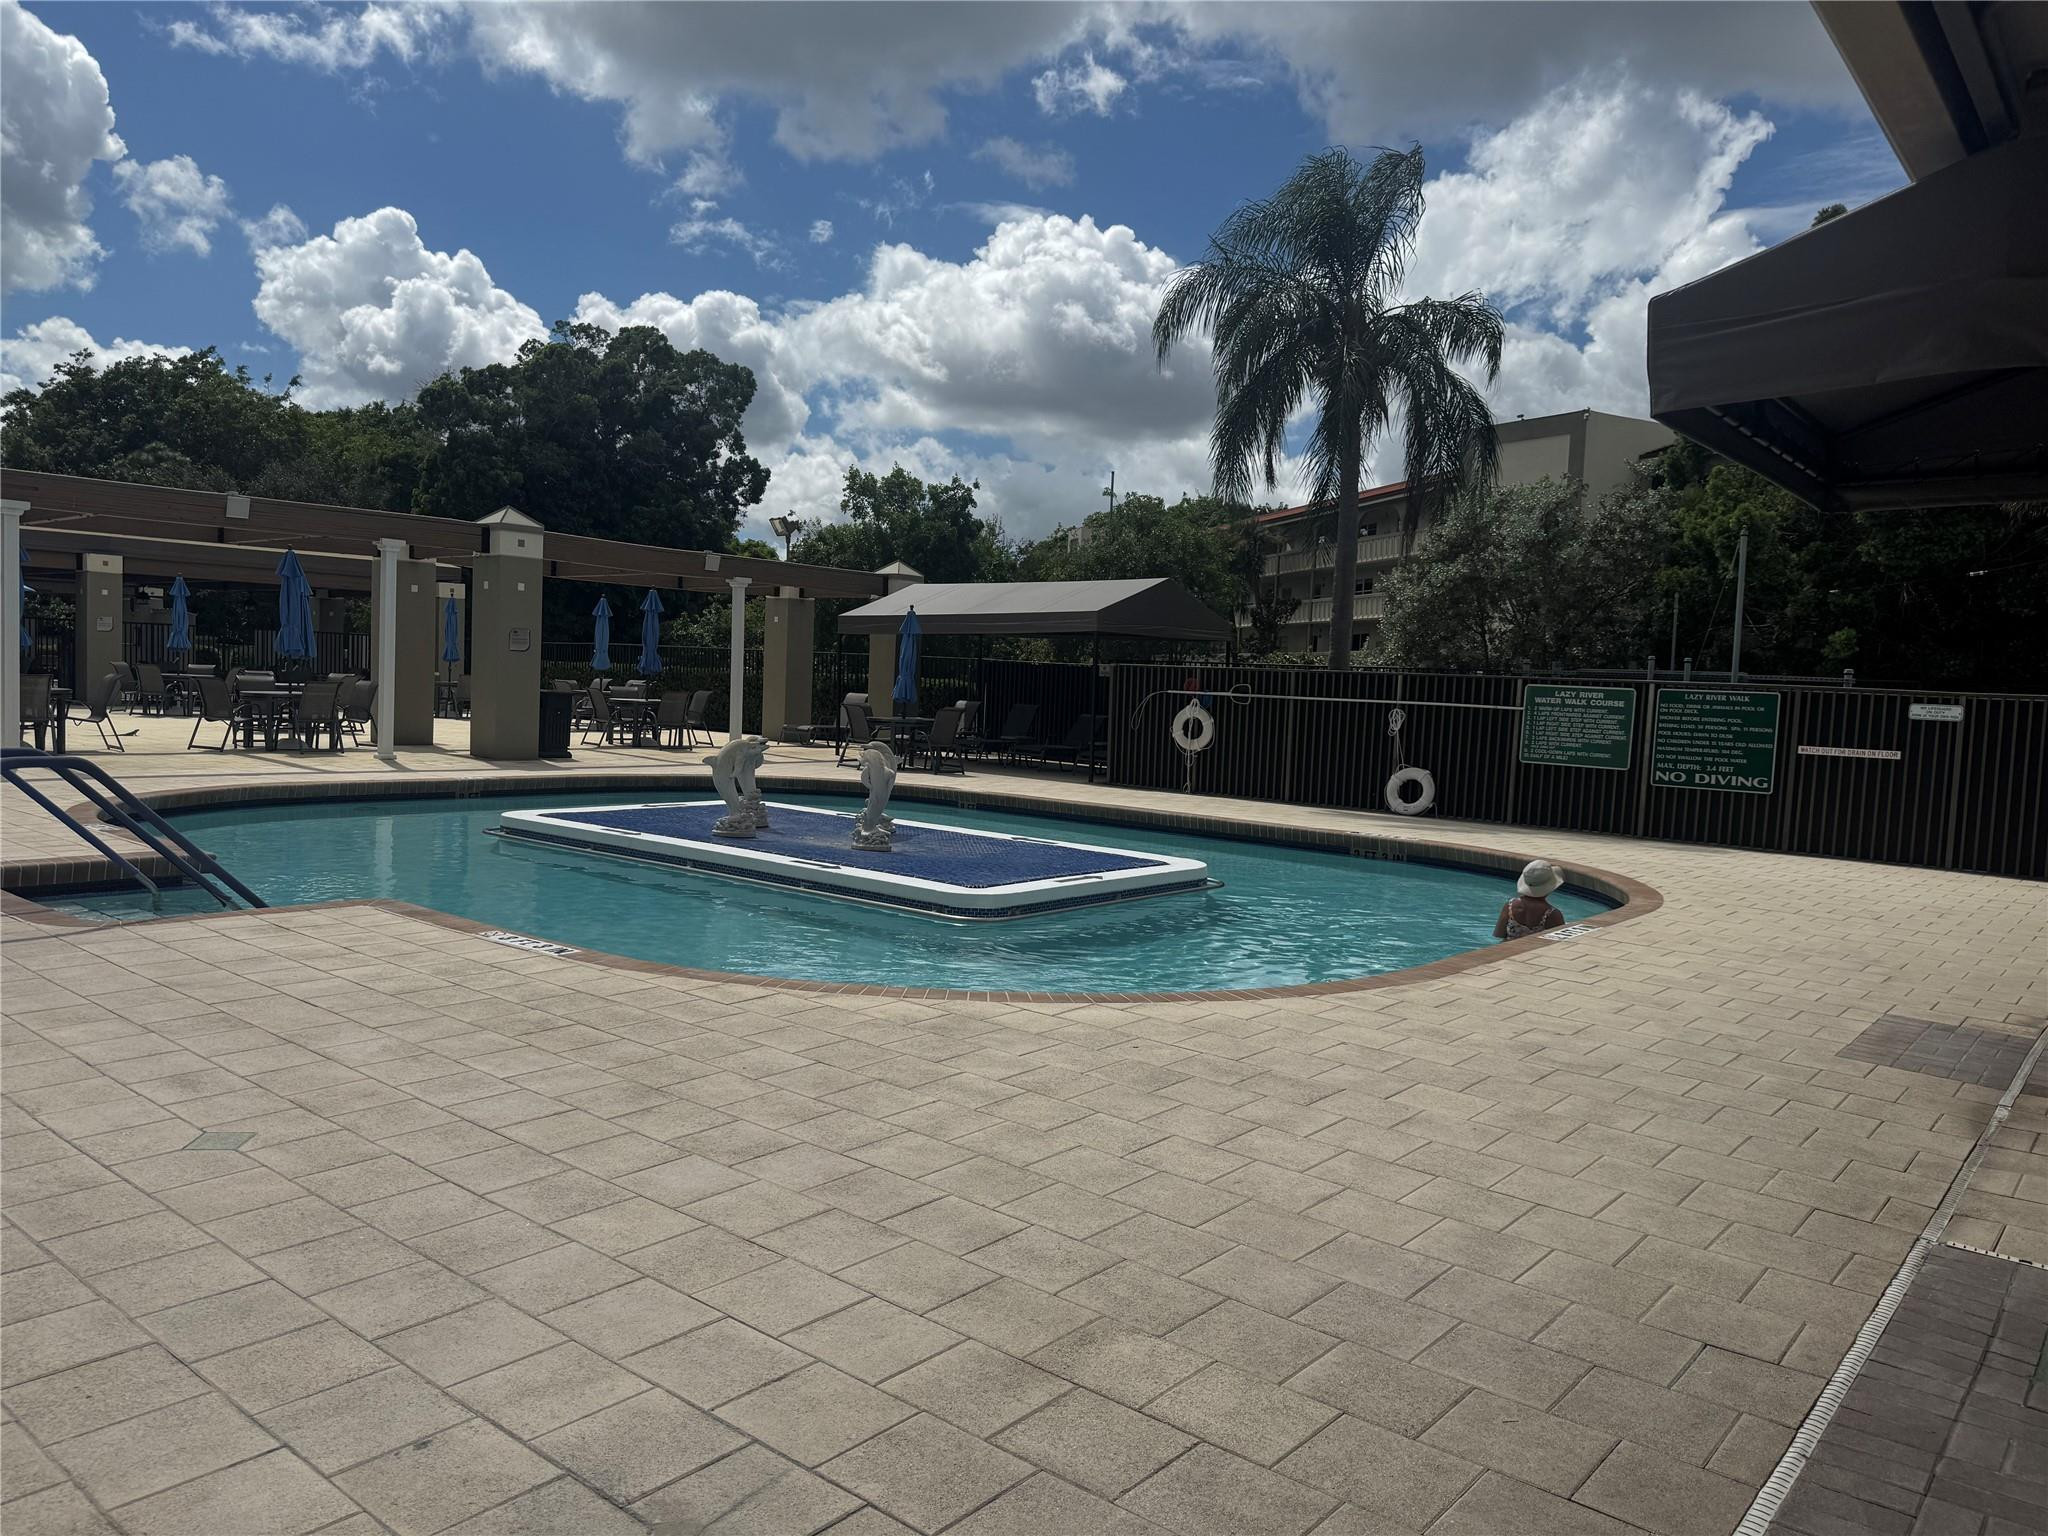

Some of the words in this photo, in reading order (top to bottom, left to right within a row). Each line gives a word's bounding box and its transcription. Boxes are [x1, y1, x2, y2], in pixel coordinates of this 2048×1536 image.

[1579, 691, 1604, 699] RIVER
[1676, 763, 1702, 771] DEPTH:
[1655, 771, 1687, 783] NO
[1694, 773, 1769, 788] DIVING
